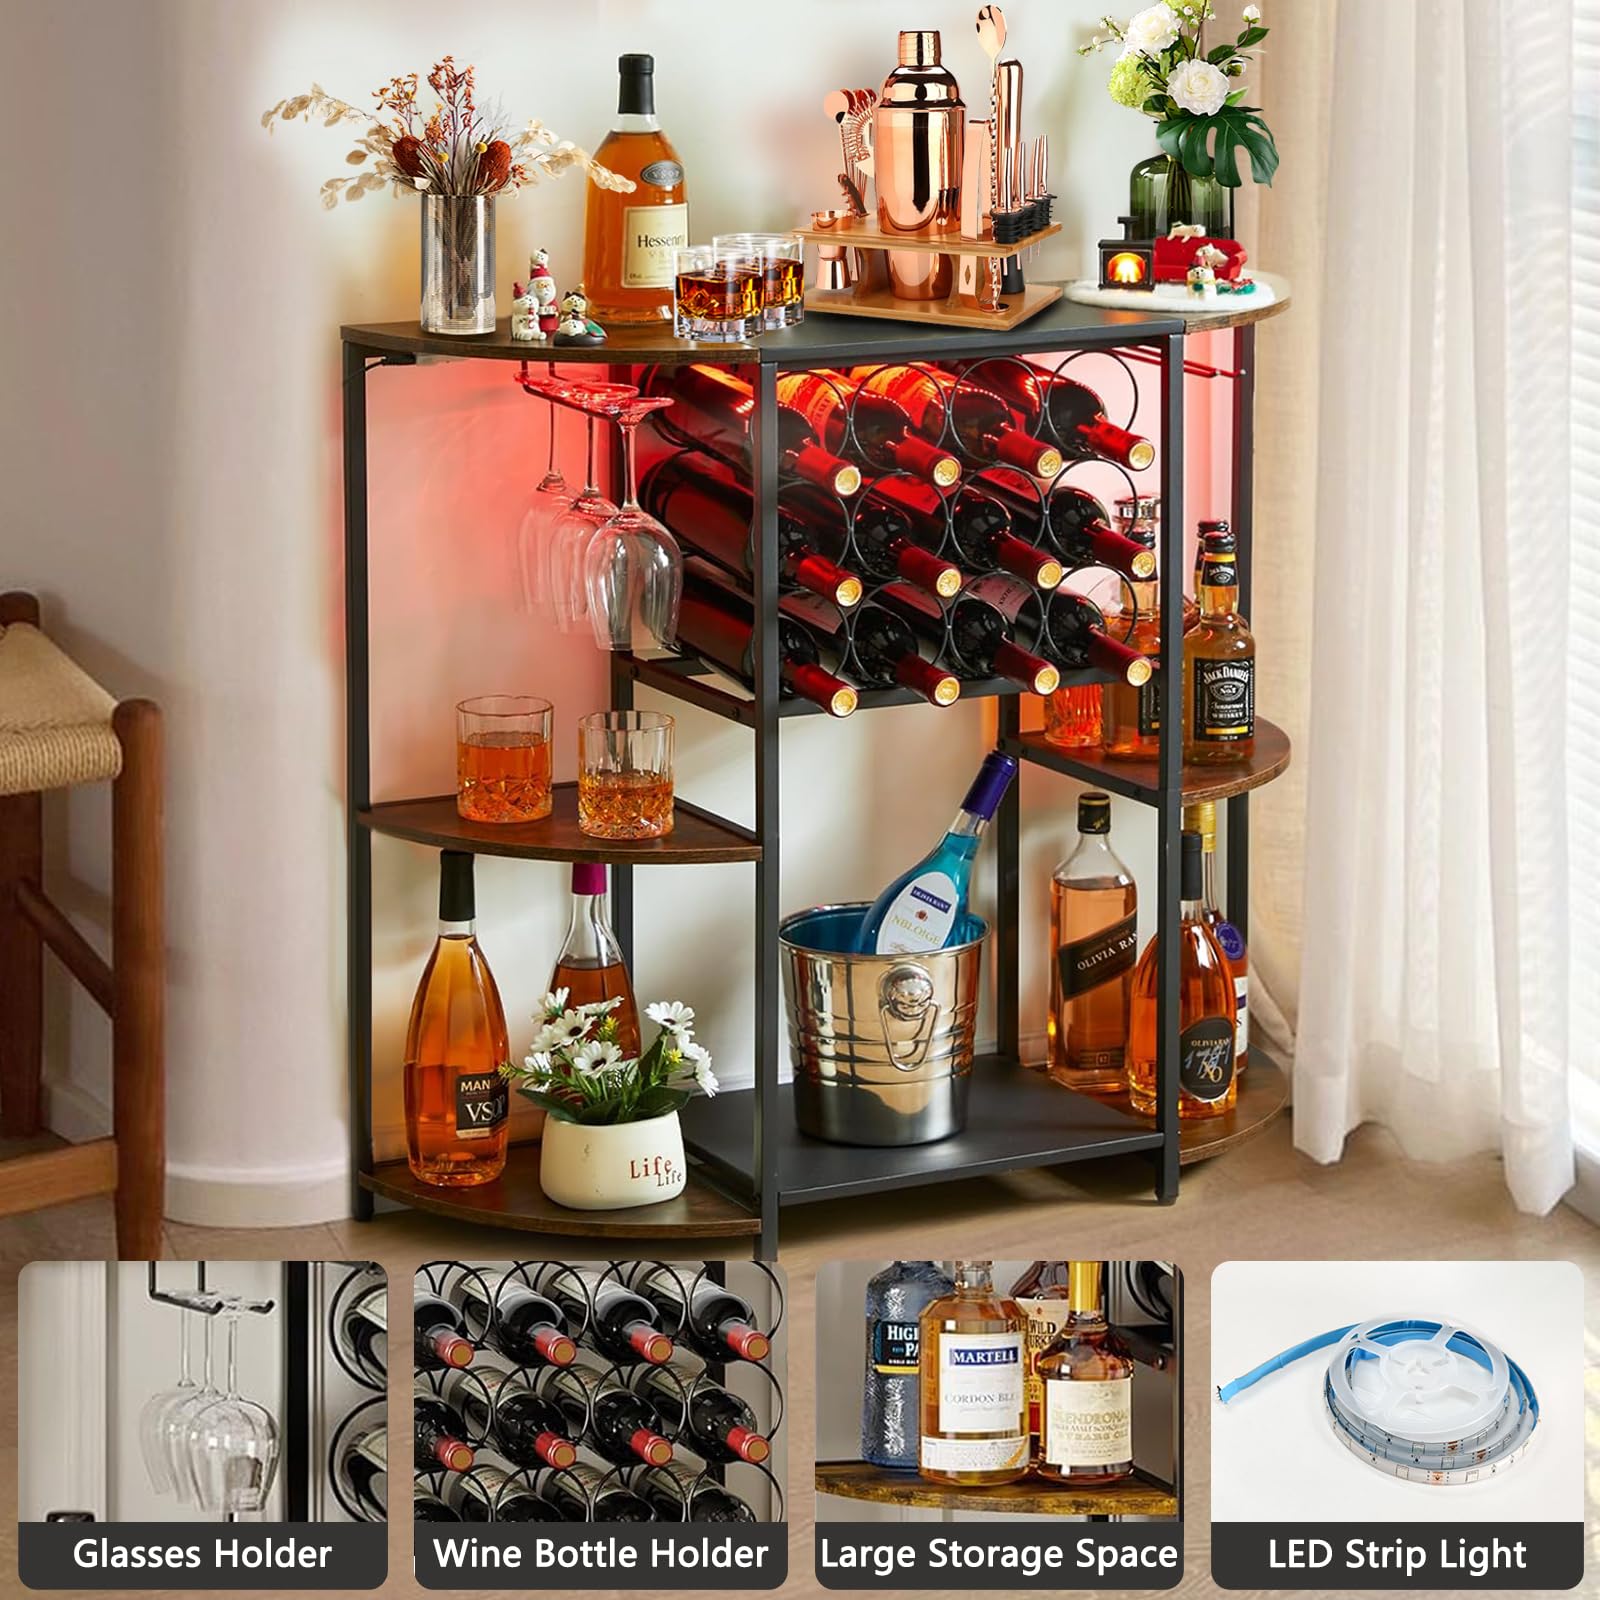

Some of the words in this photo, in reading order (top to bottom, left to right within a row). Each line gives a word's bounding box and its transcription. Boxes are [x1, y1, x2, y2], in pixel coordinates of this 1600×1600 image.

[1077, 947, 1116, 970] OLIVIA
[630, 1155, 672, 1179] Life
[1030, 1320, 1056, 1335] WILD
[954, 1348, 1017, 1364] MARTELL
[944, 1393, 995, 1404] CORDON
